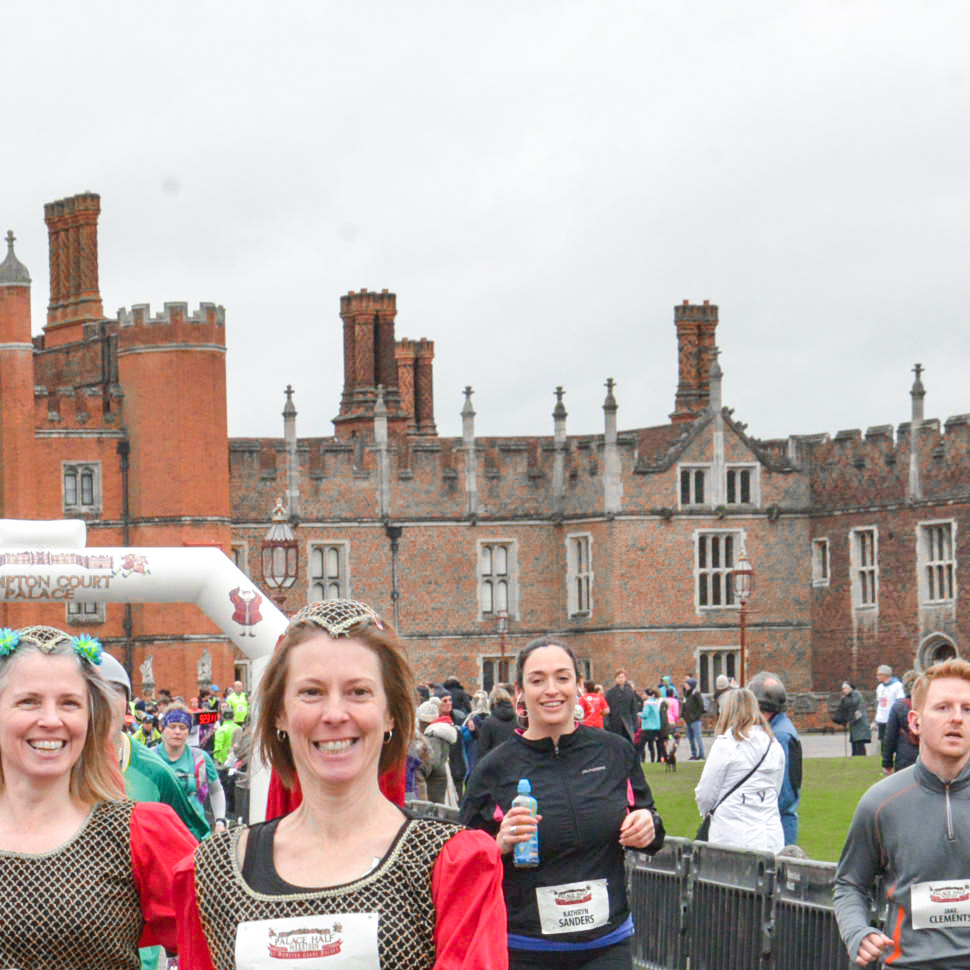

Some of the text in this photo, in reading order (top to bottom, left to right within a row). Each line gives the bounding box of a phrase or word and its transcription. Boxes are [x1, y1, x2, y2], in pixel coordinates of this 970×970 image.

[57, 575, 113, 588] COURT
[4, 588, 75, 600] PALACE
[559, 914, 595, 928] SANDERS
[274, 934, 334, 946] PALACE HALF
